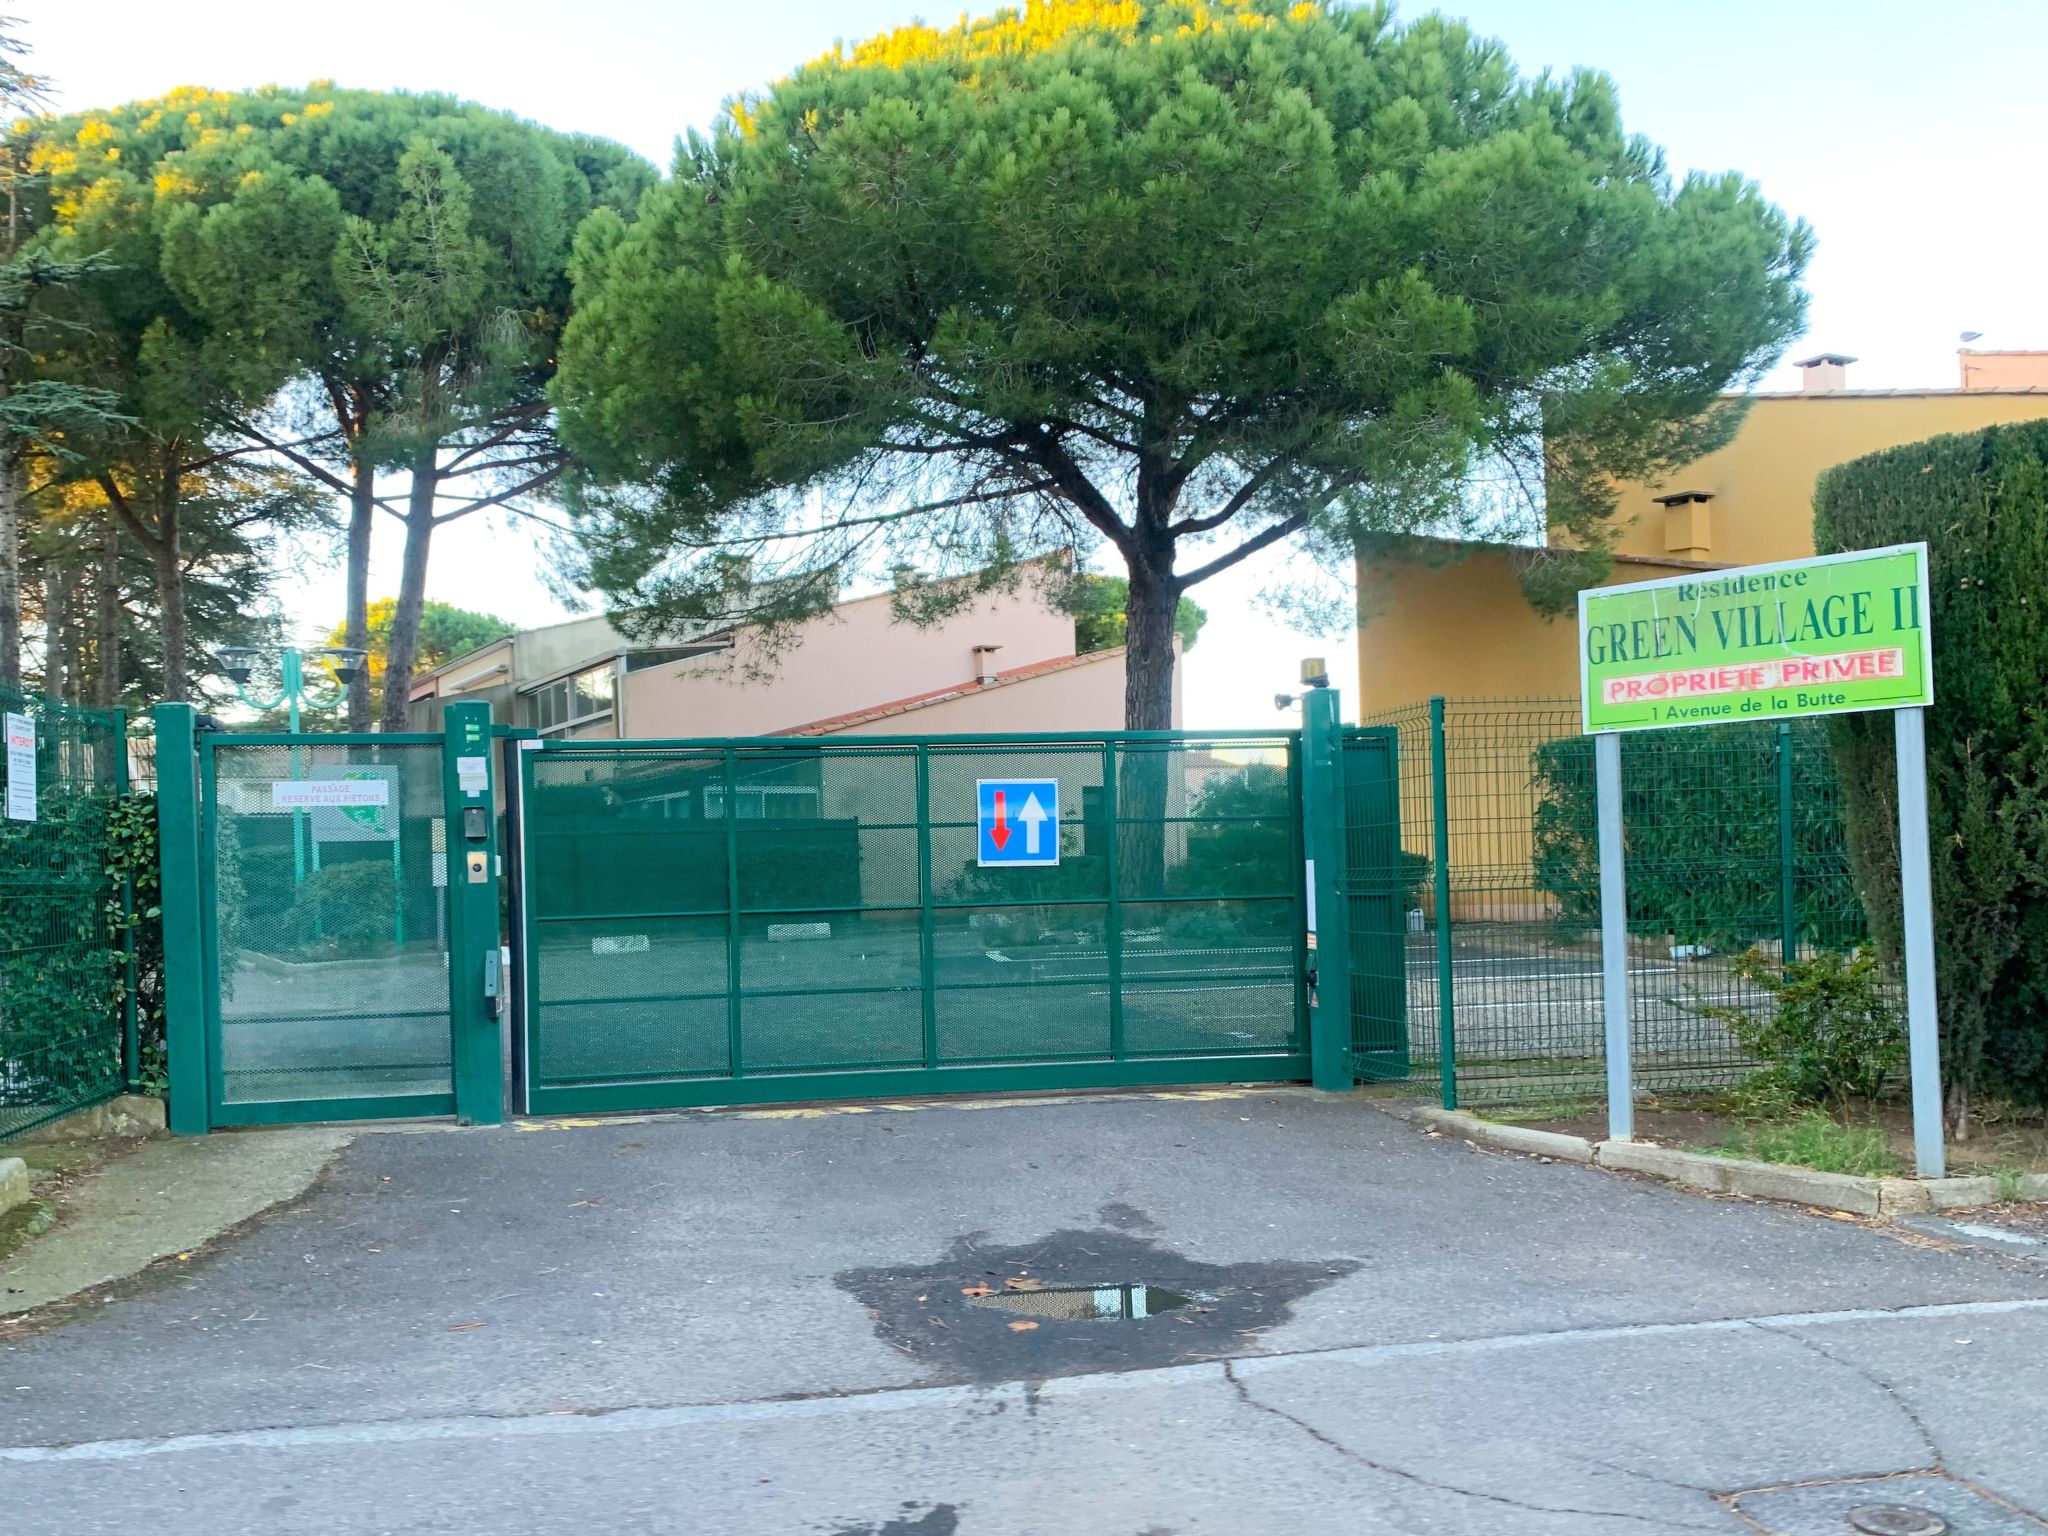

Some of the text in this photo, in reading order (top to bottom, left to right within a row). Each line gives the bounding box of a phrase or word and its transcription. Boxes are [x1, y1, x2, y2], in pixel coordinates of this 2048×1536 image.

[1587, 585, 1922, 665] GREEN VILLAGE II
[1651, 691, 1847, 721] 1 Avenue de la Butte
[311, 784, 351, 793] PASSAGE
[323, 794, 342, 804] AUX
